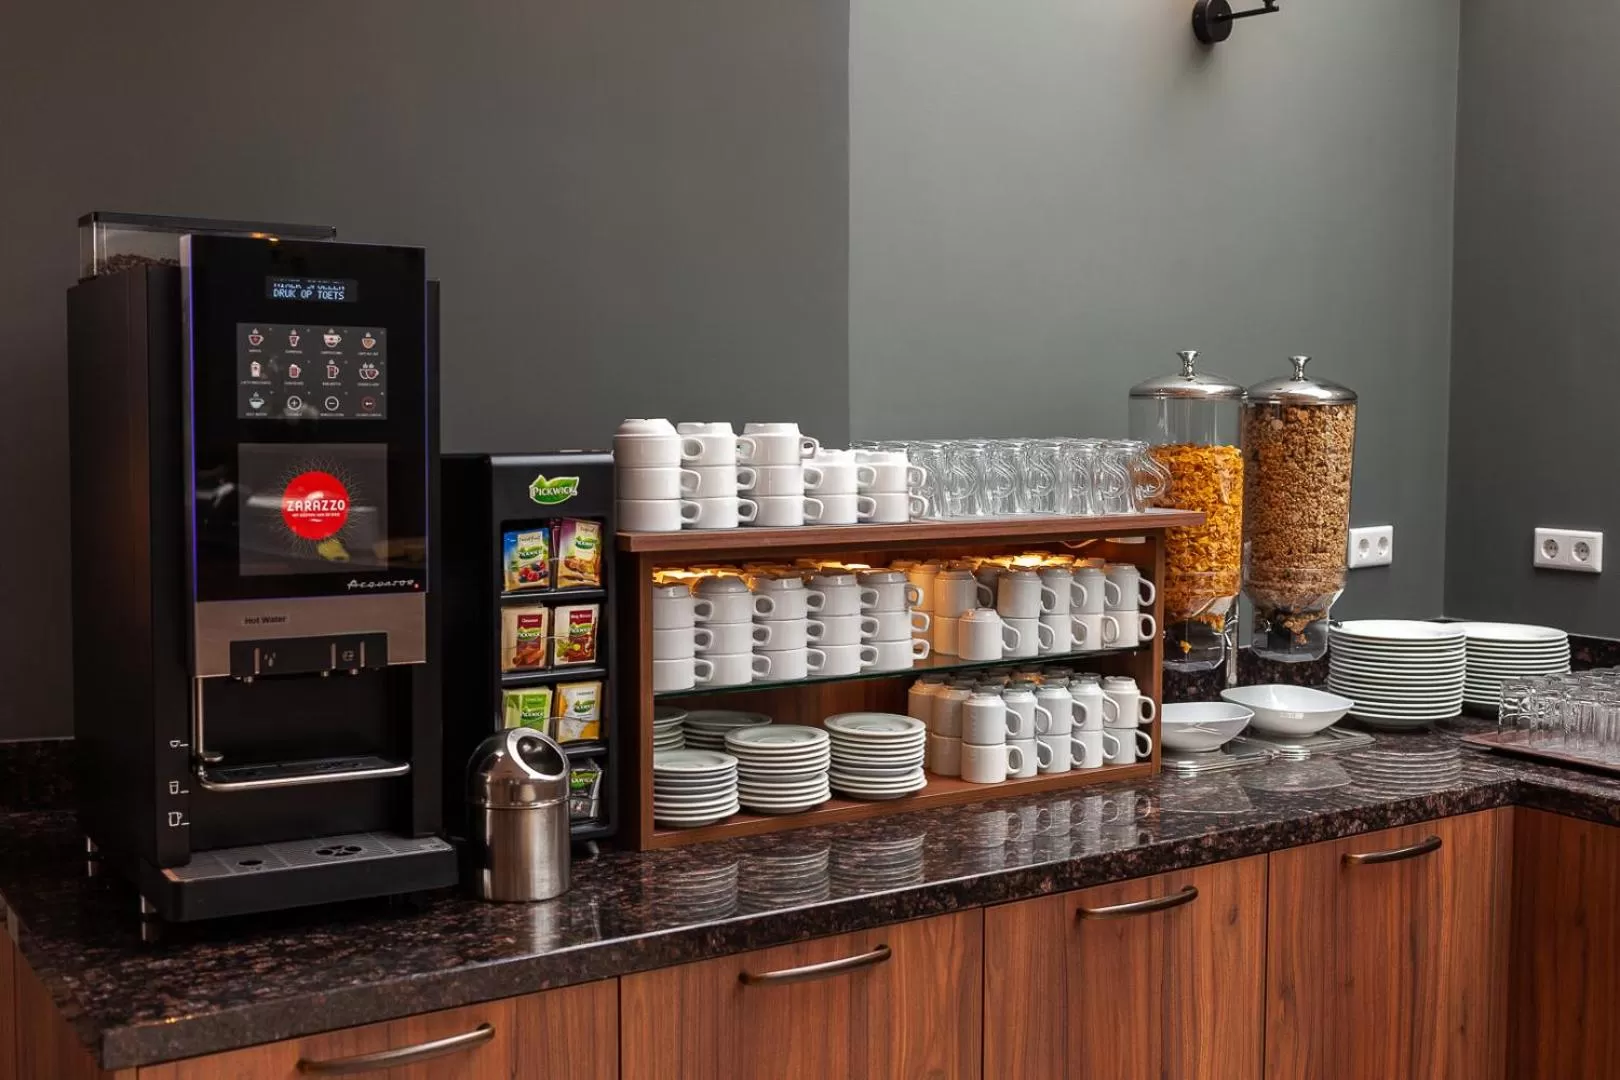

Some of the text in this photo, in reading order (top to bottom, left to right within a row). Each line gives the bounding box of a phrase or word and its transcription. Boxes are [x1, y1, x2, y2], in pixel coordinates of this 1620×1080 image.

[273, 288, 345, 300] DRUK OP TOETS
[531, 486, 577, 497] PICKWICK
[286, 499, 346, 512] ZARAZZO
[244, 615, 289, 625] Hot Water
